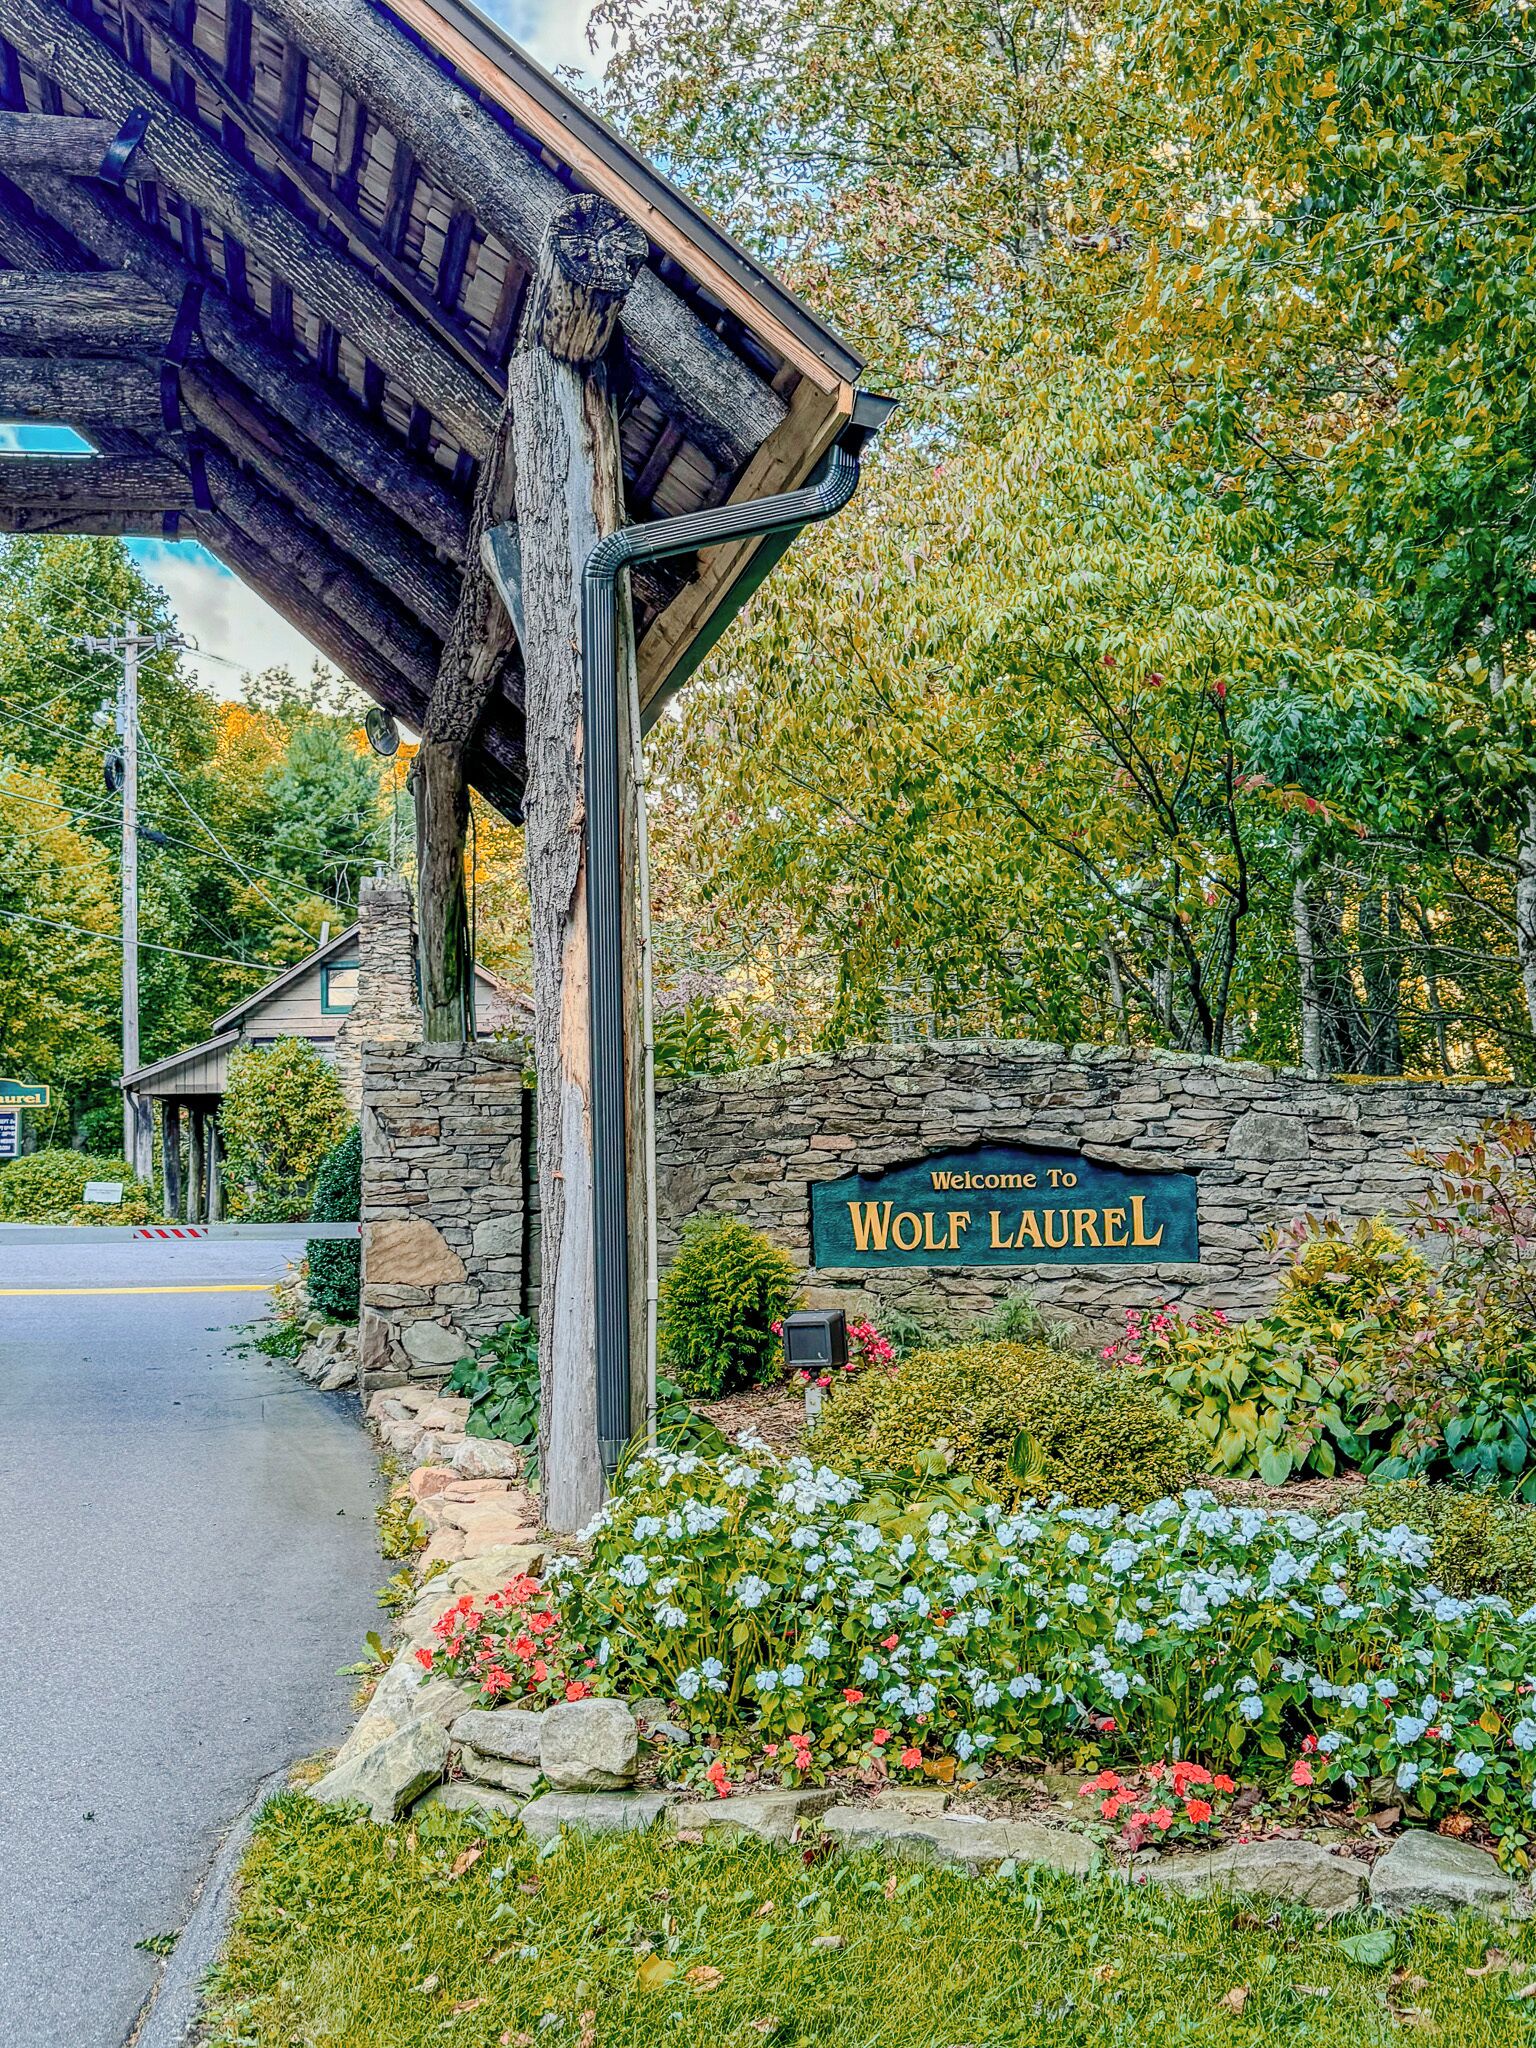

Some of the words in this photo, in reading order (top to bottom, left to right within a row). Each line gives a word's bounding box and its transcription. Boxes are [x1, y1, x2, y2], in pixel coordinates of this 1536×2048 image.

[931, 1170, 1037, 1190] Welcome
[1047, 1169, 1078, 1188] To
[847, 1201, 972, 1251] WOLF
[990, 1195, 1164, 1248] LAUREL
